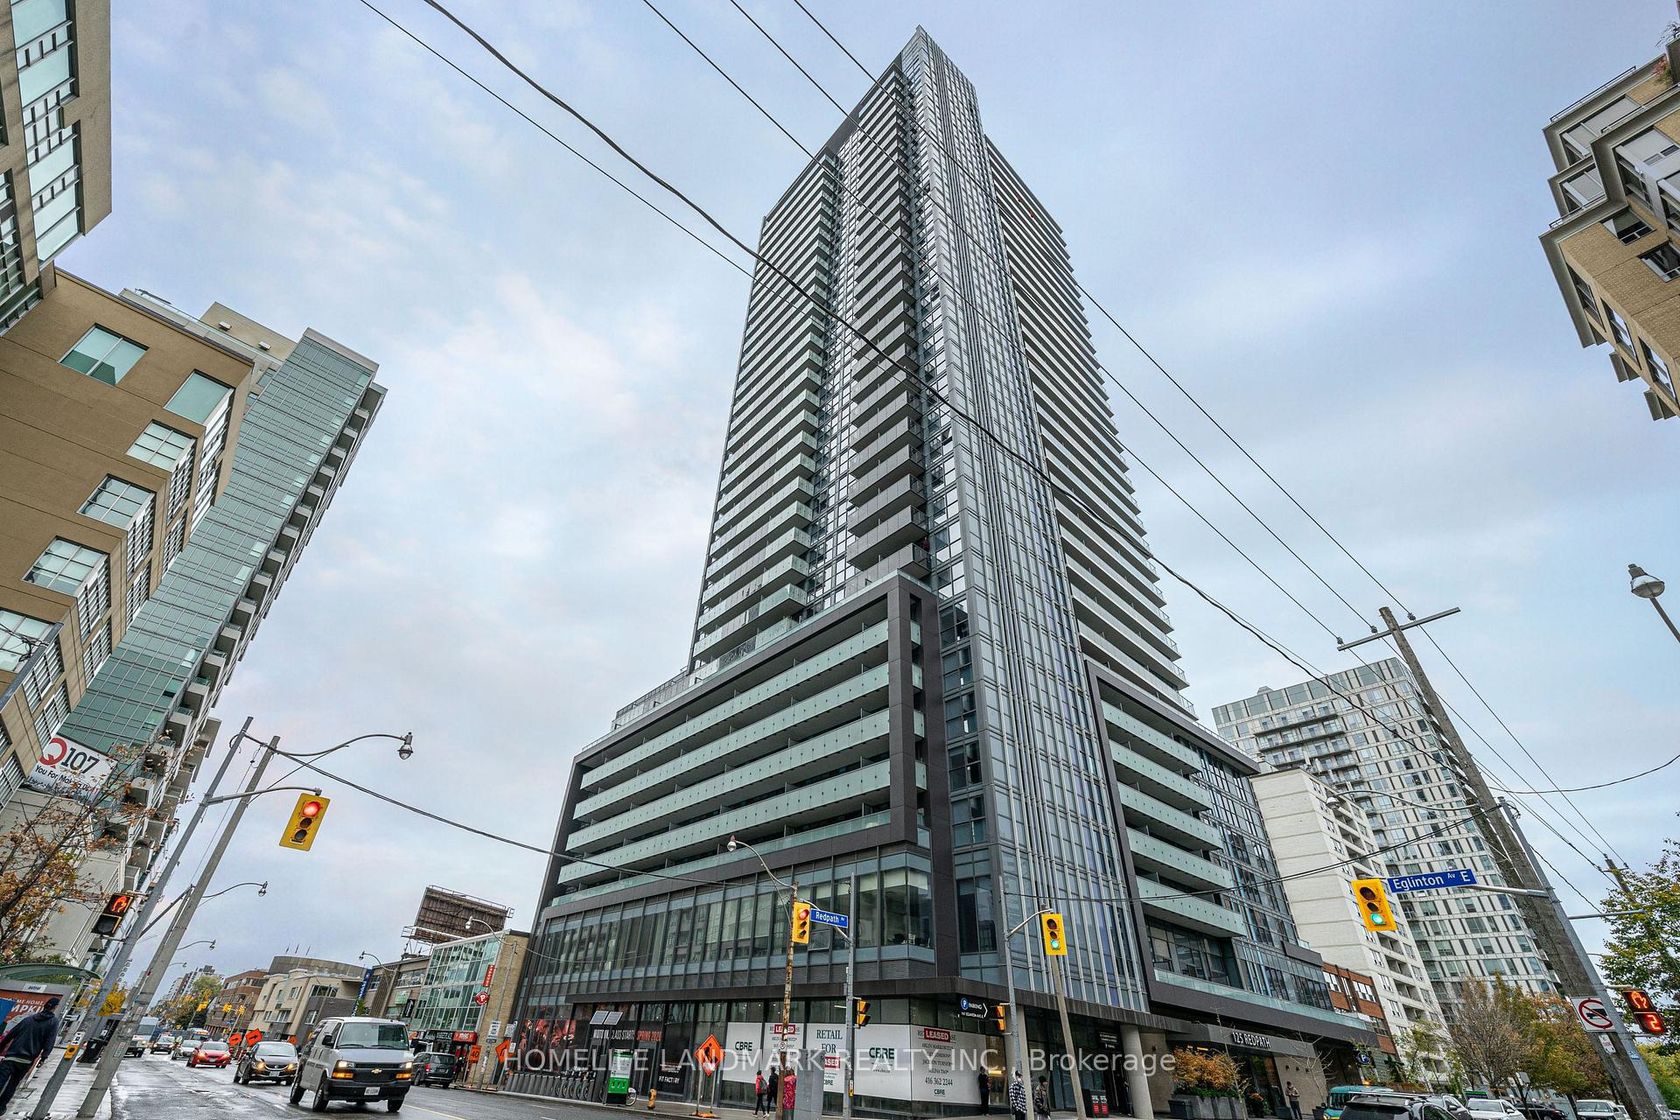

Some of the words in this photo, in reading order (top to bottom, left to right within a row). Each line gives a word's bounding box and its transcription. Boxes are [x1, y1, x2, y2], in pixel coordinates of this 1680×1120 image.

[39, 738, 100, 773] Q107
[35, 765, 48, 775] You
[1393, 875, 1445, 891] Eglinton
[1460, 871, 1471, 882] E
[815, 911, 840, 923] Redpath
[1646, 1014, 1661, 1030] 2
[816, 1029, 843, 1040] RETAIL
[925, 1029, 949, 1041] LEASED
[1232, 1031, 1244, 1044] 125
[1244, 1033, 1272, 1048] REDPATH
[735, 1041, 753, 1052] CBRE
[821, 1043, 837, 1054] FOR
[869, 1047, 895, 1060] CBRE
